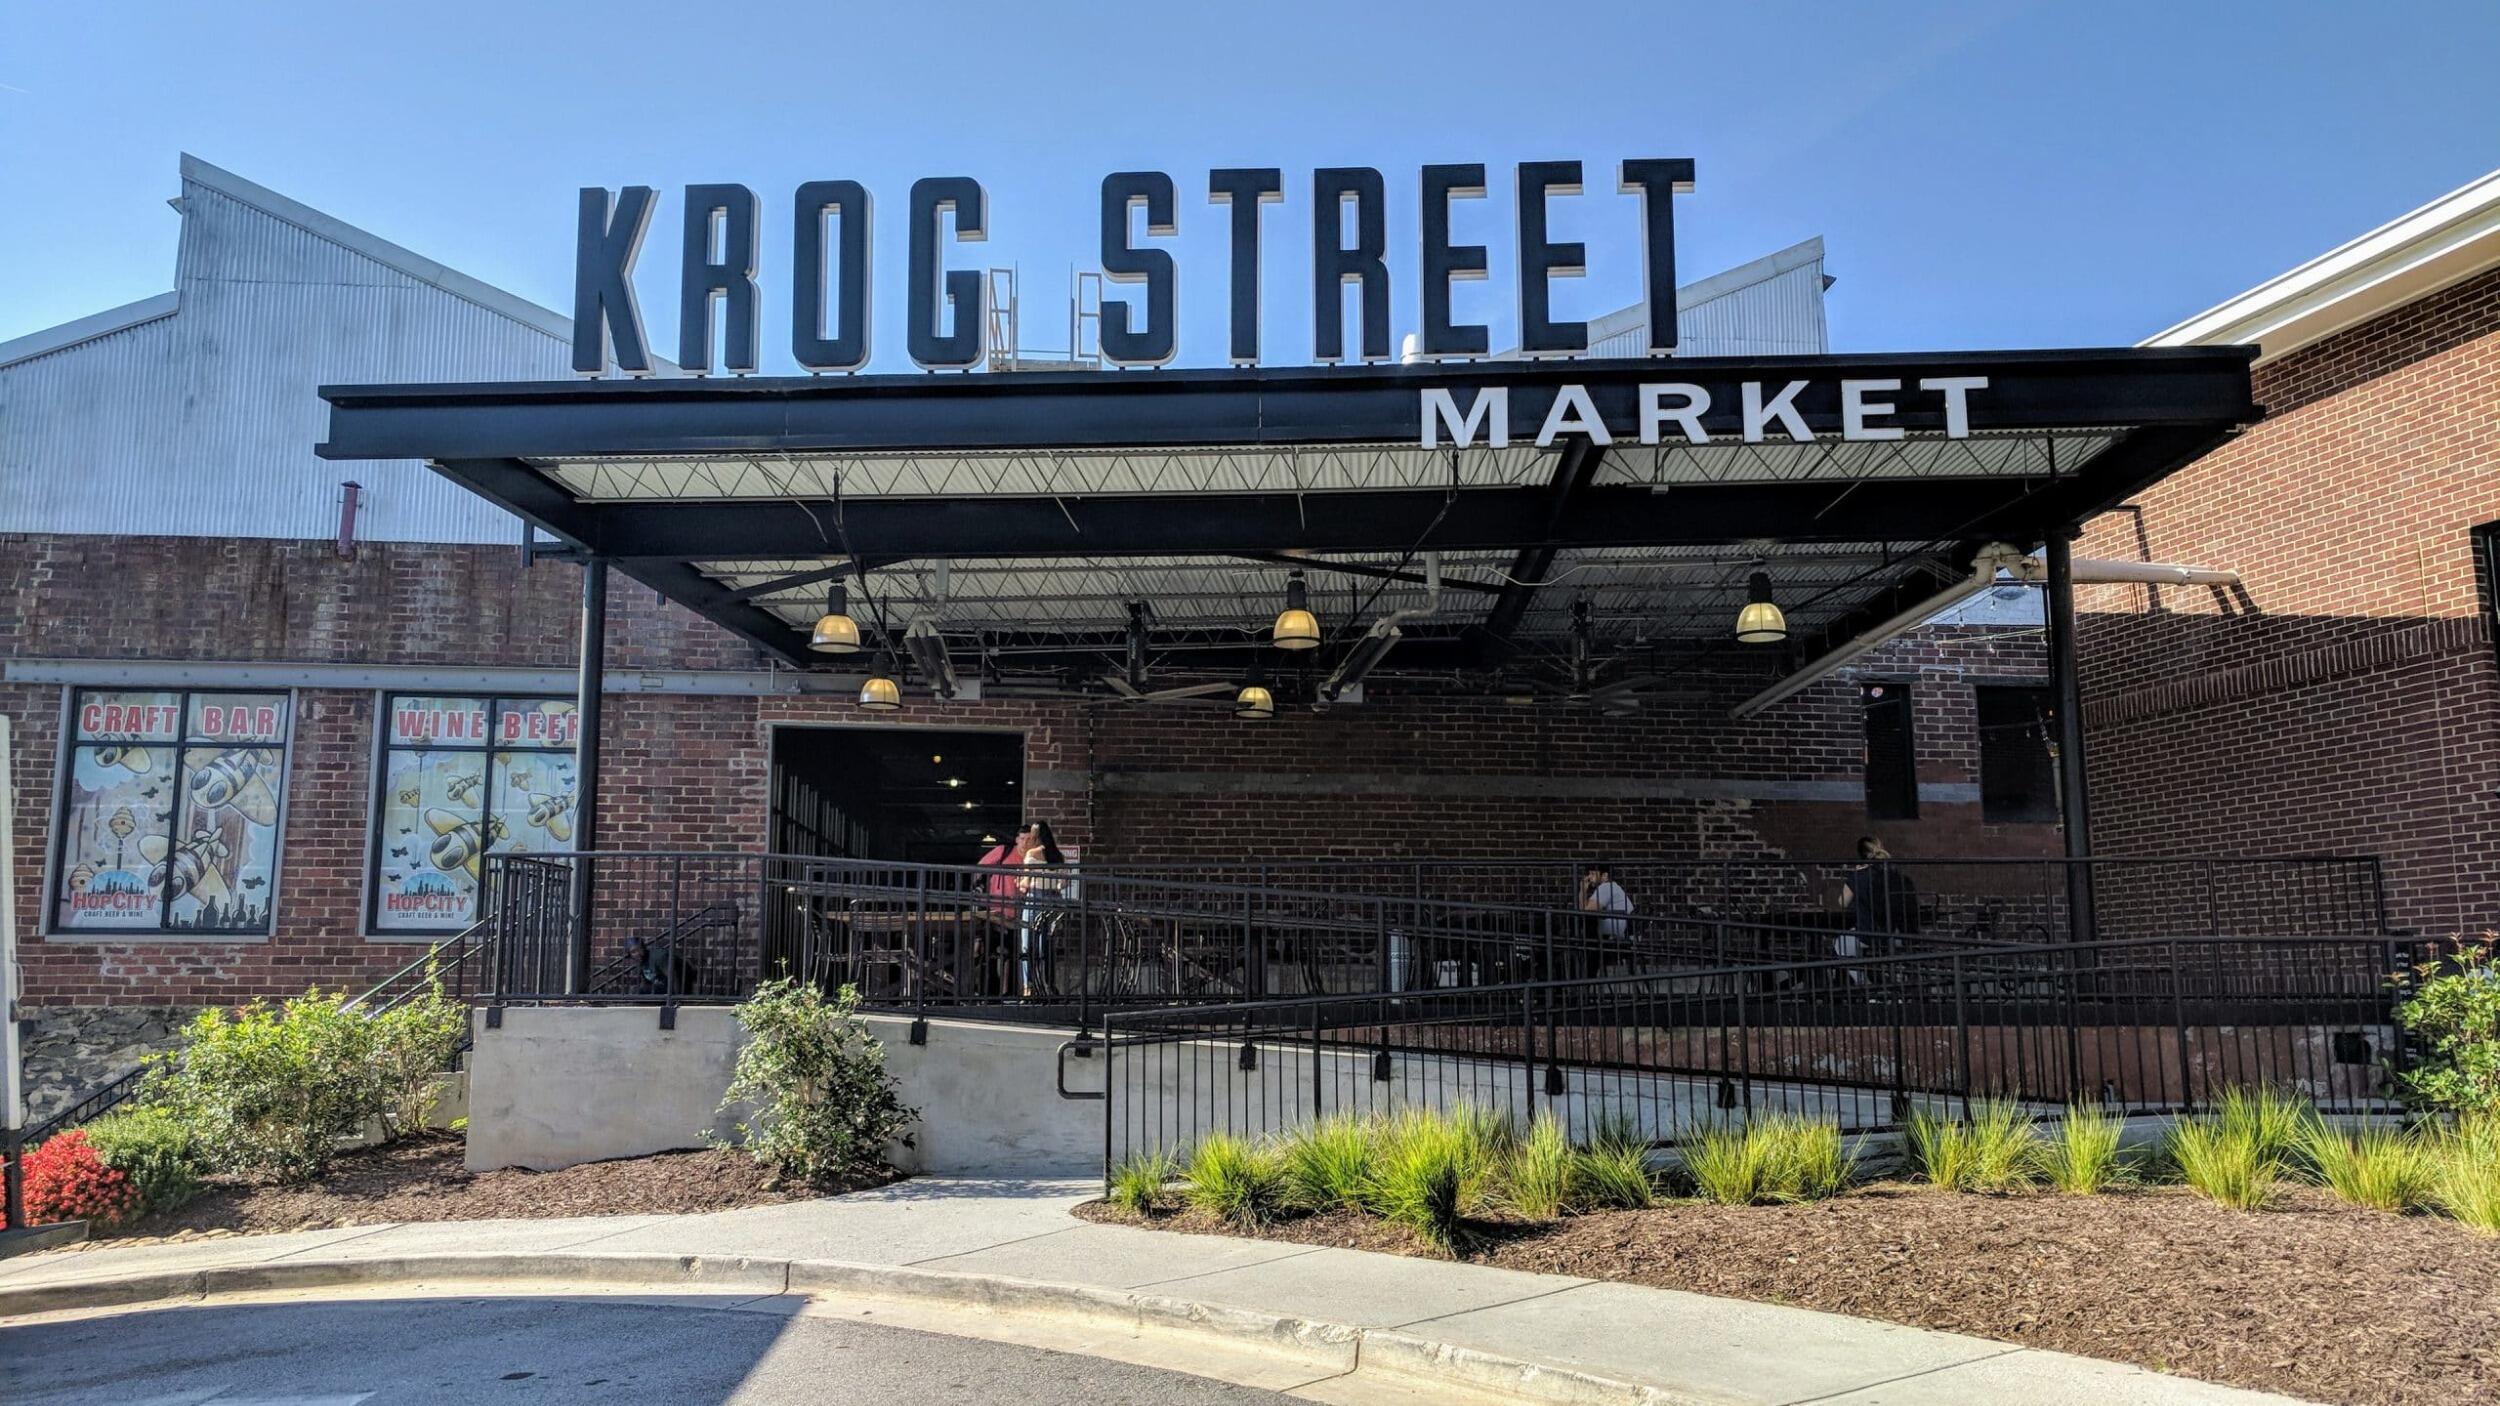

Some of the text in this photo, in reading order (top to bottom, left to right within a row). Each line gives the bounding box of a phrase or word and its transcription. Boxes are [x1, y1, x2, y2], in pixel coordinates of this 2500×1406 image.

[572, 157, 1696, 378] KROG STREET
[1419, 376, 1989, 450] MARKET
[82, 704, 275, 736] CRAFT BAR
[397, 710, 485, 740] WINE
